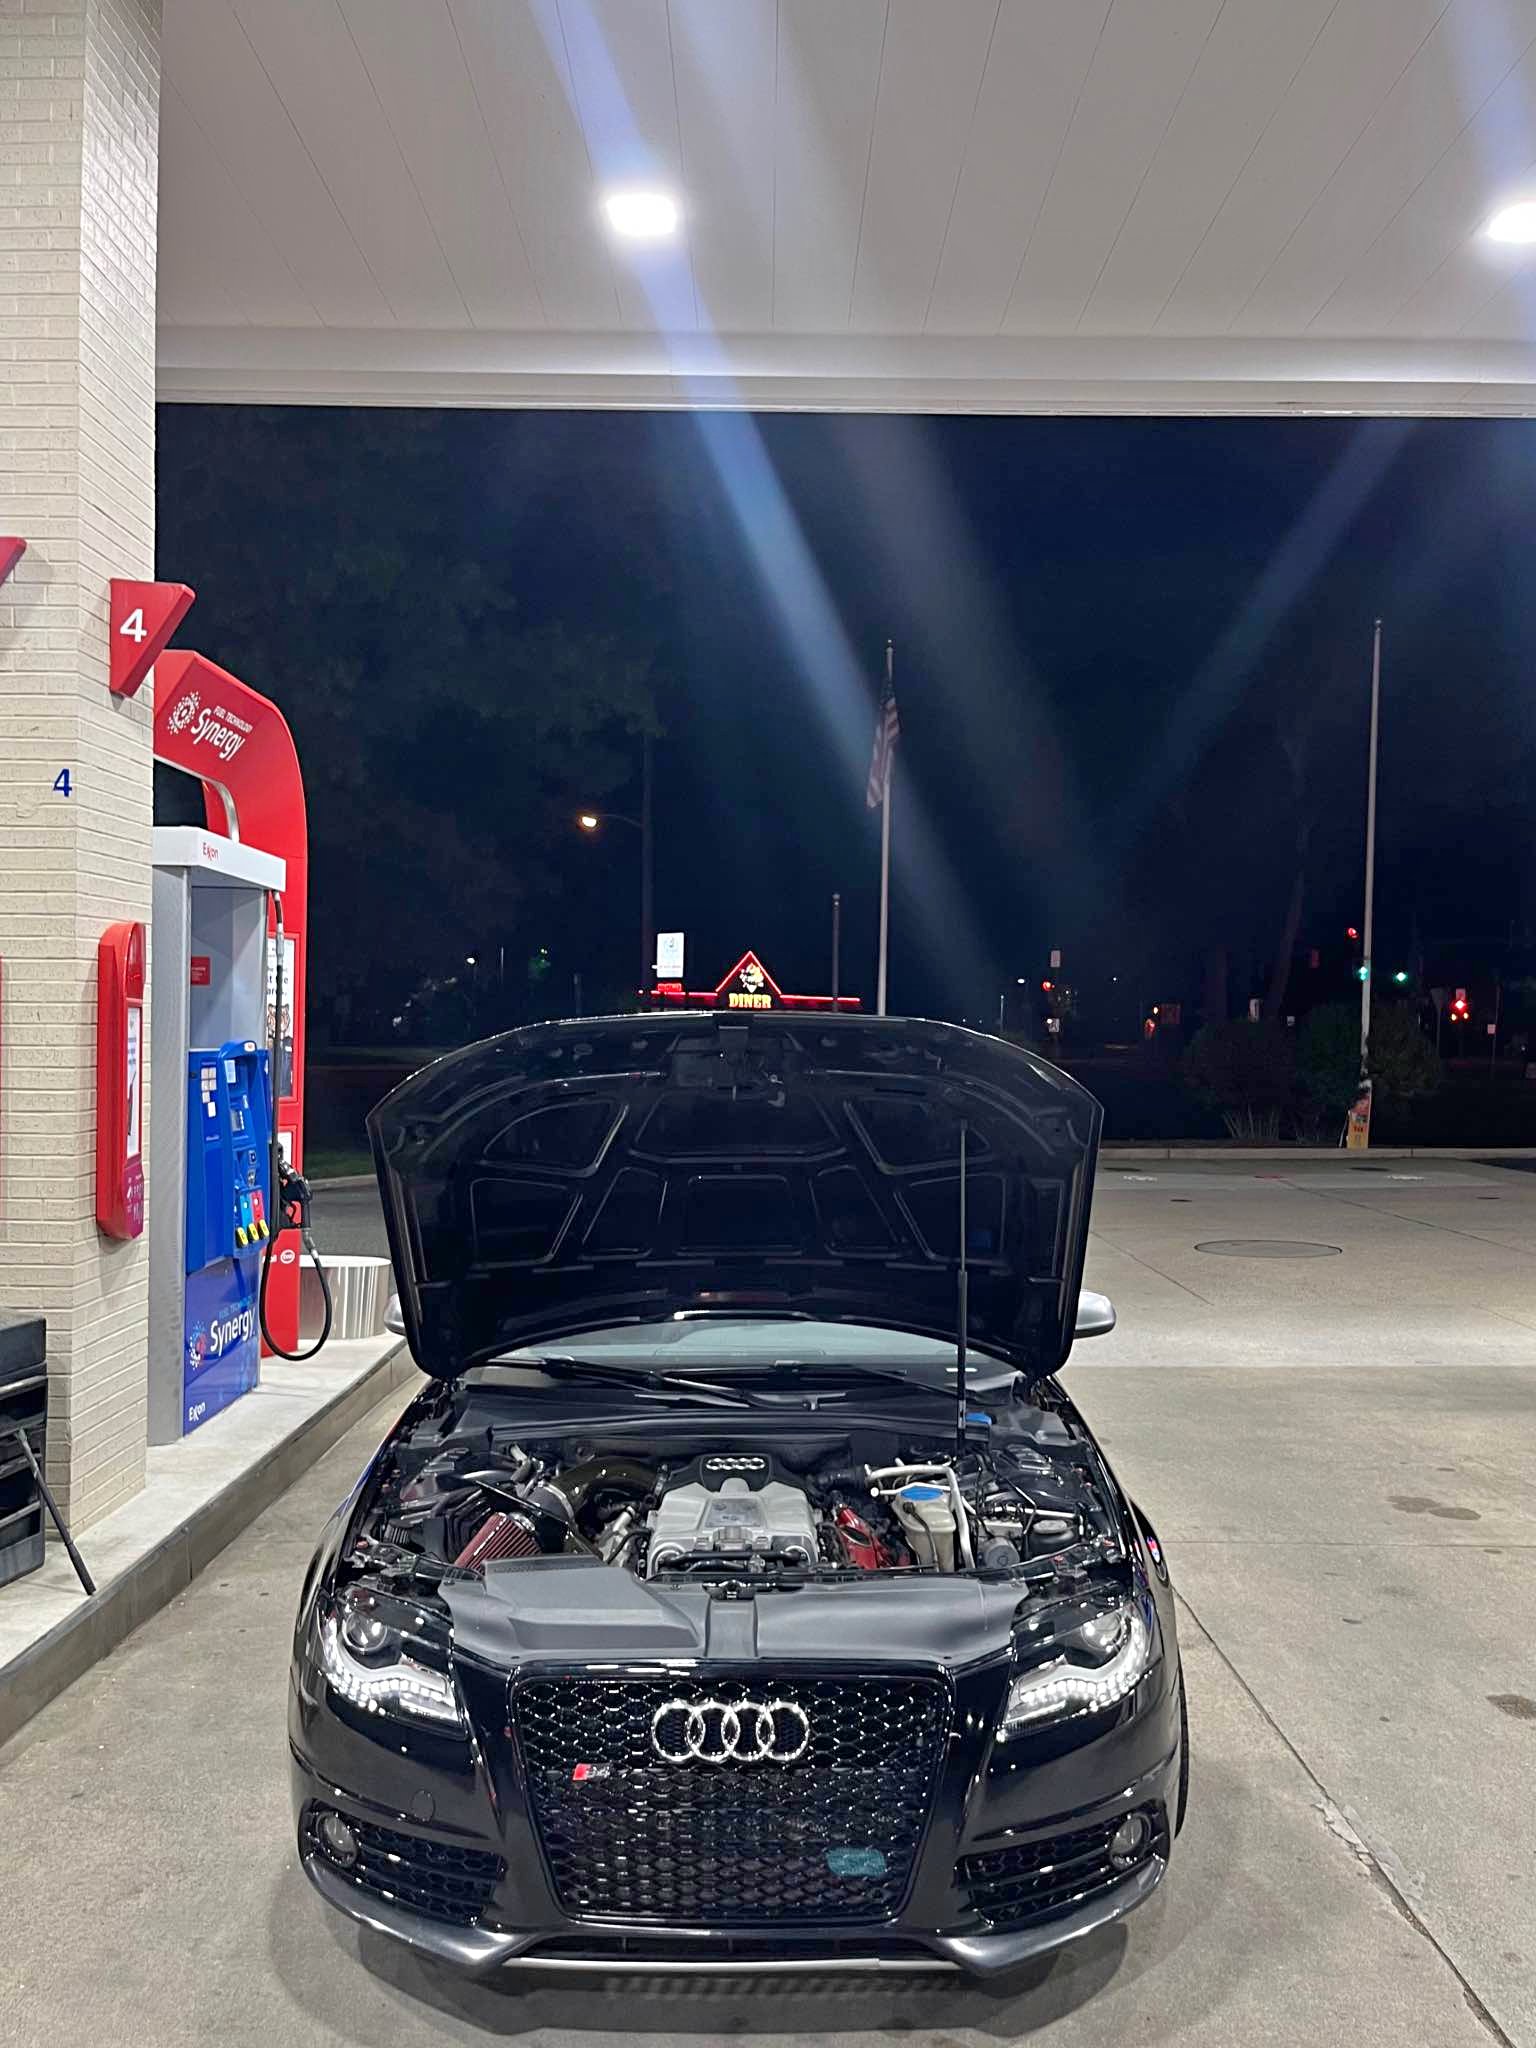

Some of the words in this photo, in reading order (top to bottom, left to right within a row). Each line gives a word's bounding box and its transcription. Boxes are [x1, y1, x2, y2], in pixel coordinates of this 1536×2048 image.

[119, 608, 147, 643] 4
[190, 707, 246, 762] Synergy
[53, 768, 73, 797] 4
[728, 993, 772, 1009] DINER
[210, 1306, 256, 1356] Synergy
